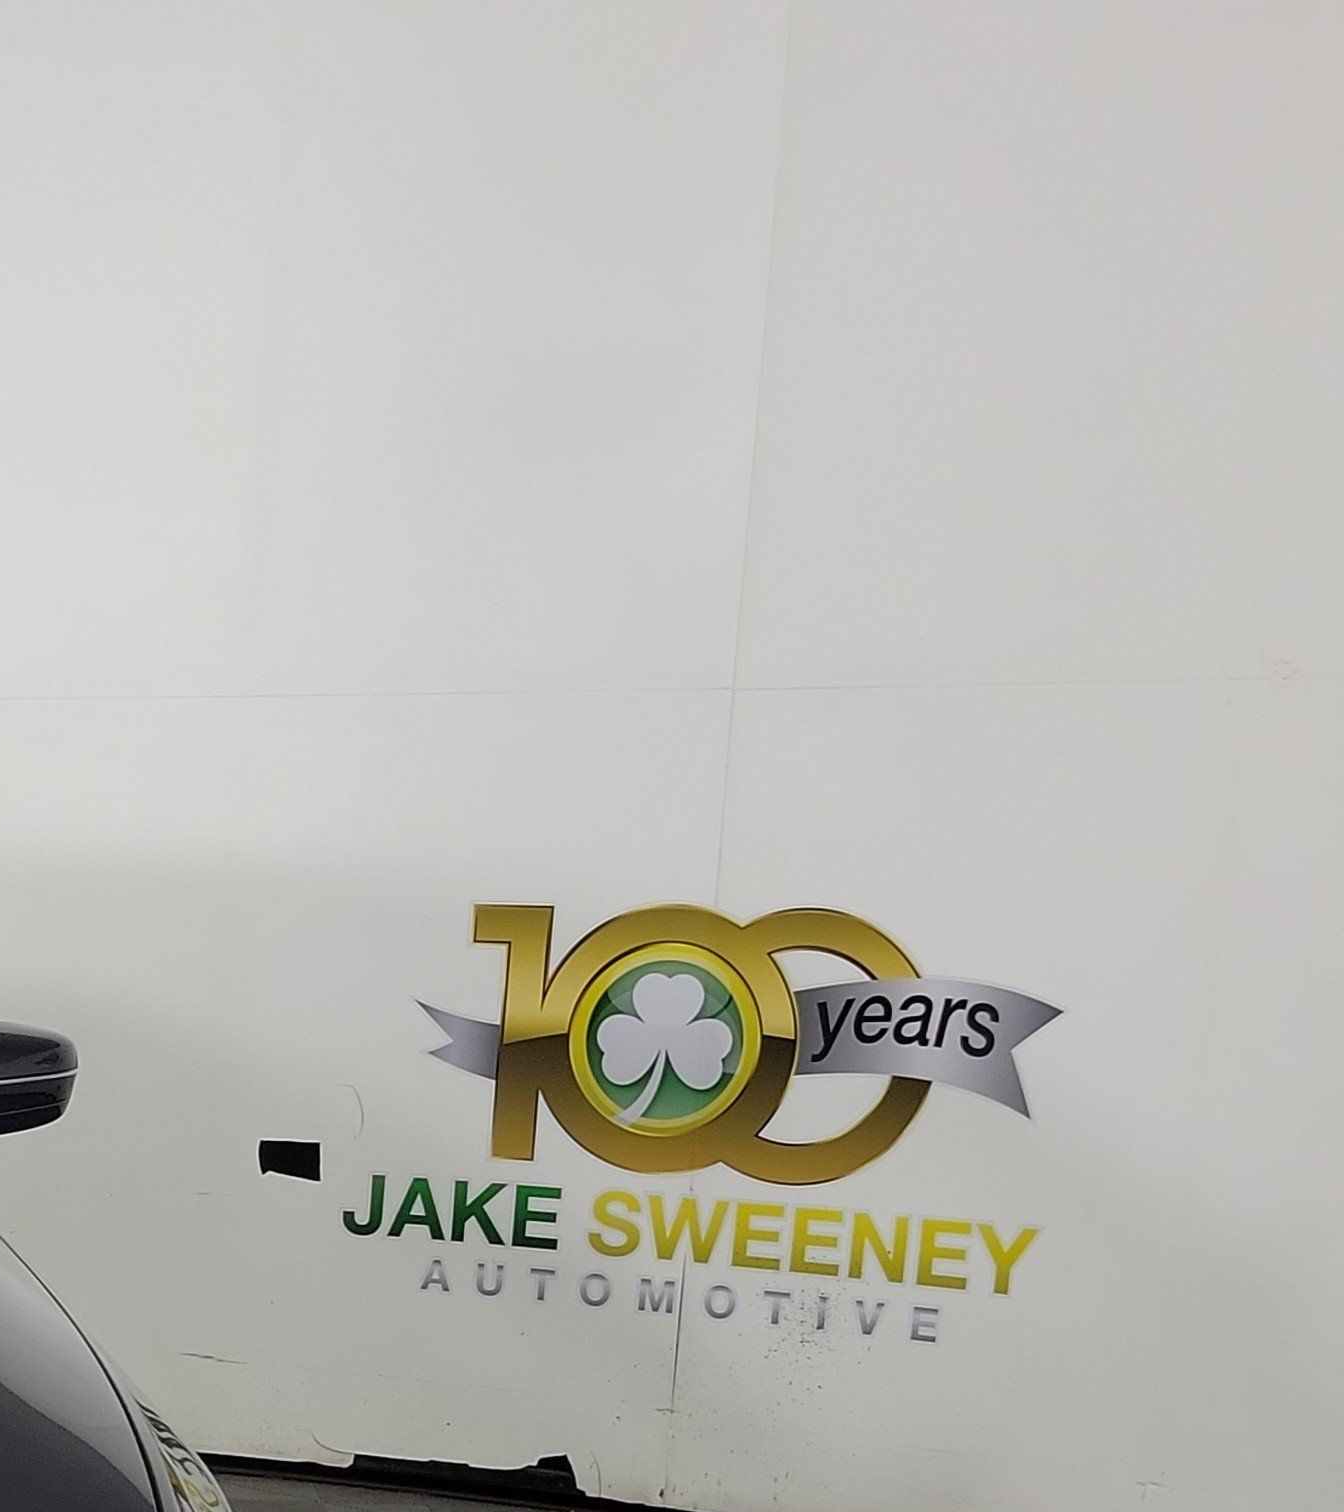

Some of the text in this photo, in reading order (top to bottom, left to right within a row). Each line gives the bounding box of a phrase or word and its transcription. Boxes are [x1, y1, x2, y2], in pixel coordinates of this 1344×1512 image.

[472, 903, 933, 1186] 100
[810, 992, 1001, 1063] years
[341, 1174, 1040, 1296] JAKE SWEENEY
[420, 1258, 941, 1344] AUTOMOTIVE
